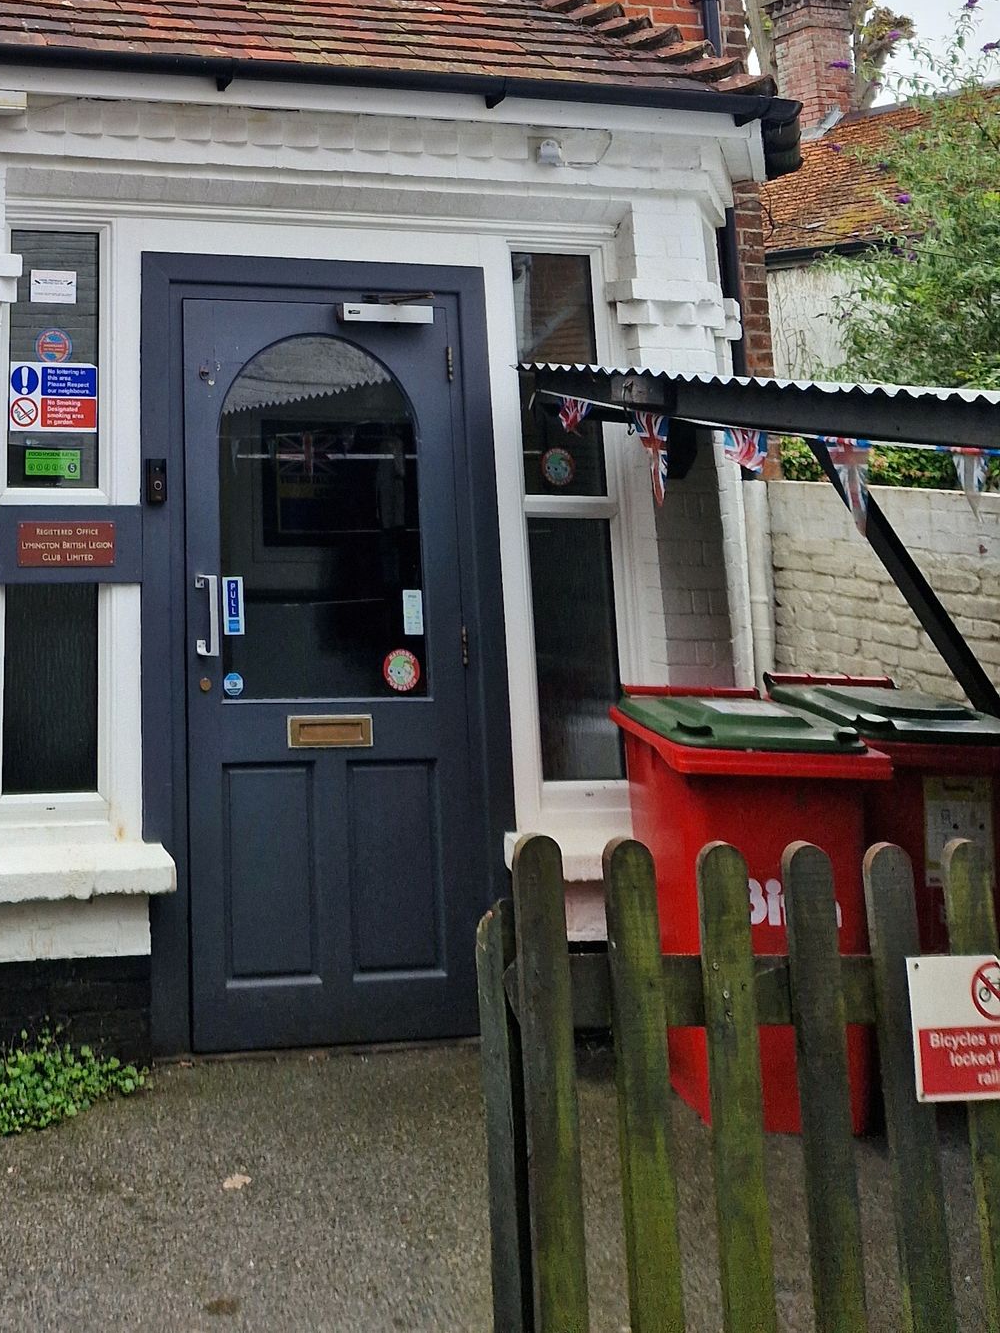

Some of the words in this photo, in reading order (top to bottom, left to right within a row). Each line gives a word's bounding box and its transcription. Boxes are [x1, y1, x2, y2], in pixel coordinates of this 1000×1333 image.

[56, 368, 79, 376] loitering
[47, 406, 79, 414] Designated
[36, 528, 73, 536] REGISTERED
[21, 541, 60, 550] LYMINGTON
[62, 541, 86, 549] BRITISH
[88, 541, 113, 549] LEGION
[42, 553, 61, 562] CLUB
[229, 582, 237, 615] PULL
[929, 1031, 987, 1051] Bicycles
[949, 1050, 995, 1067] locked
